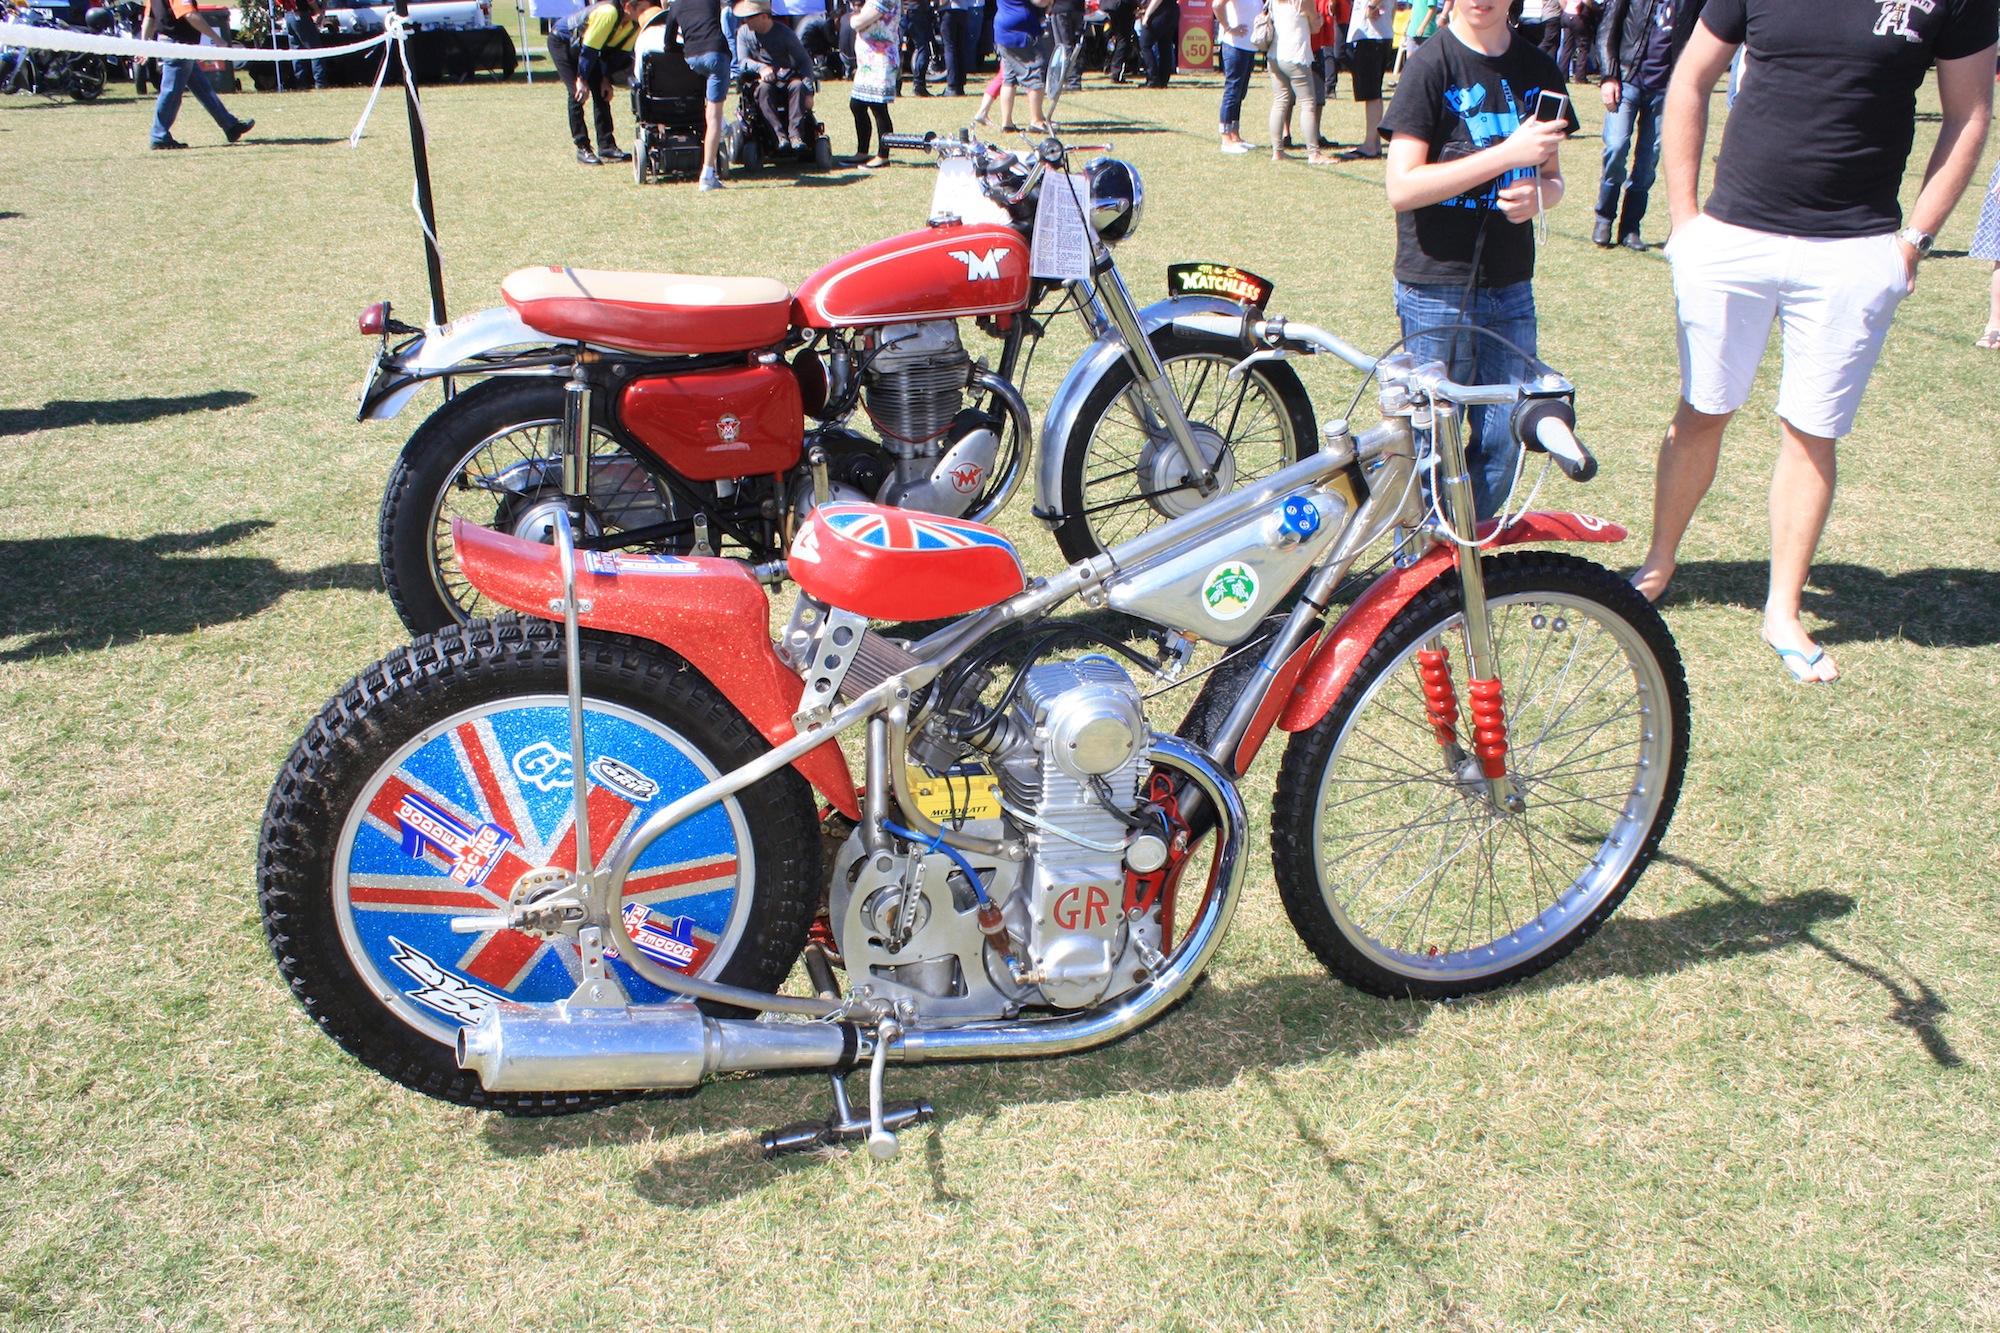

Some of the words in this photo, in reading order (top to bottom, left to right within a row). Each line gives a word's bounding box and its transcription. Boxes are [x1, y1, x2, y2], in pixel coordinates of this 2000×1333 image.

[1186, 44, 1207, 57] $50
[1178, 272, 1262, 301] MATCHLESS
[601, 764, 652, 793] GRIP
[614, 767, 653, 787] PRO
[400, 805, 466, 853] GODDEN
[455, 828, 497, 882] RACING
[1053, 886, 1109, 931] GR
[635, 931, 693, 958] GODDEN
